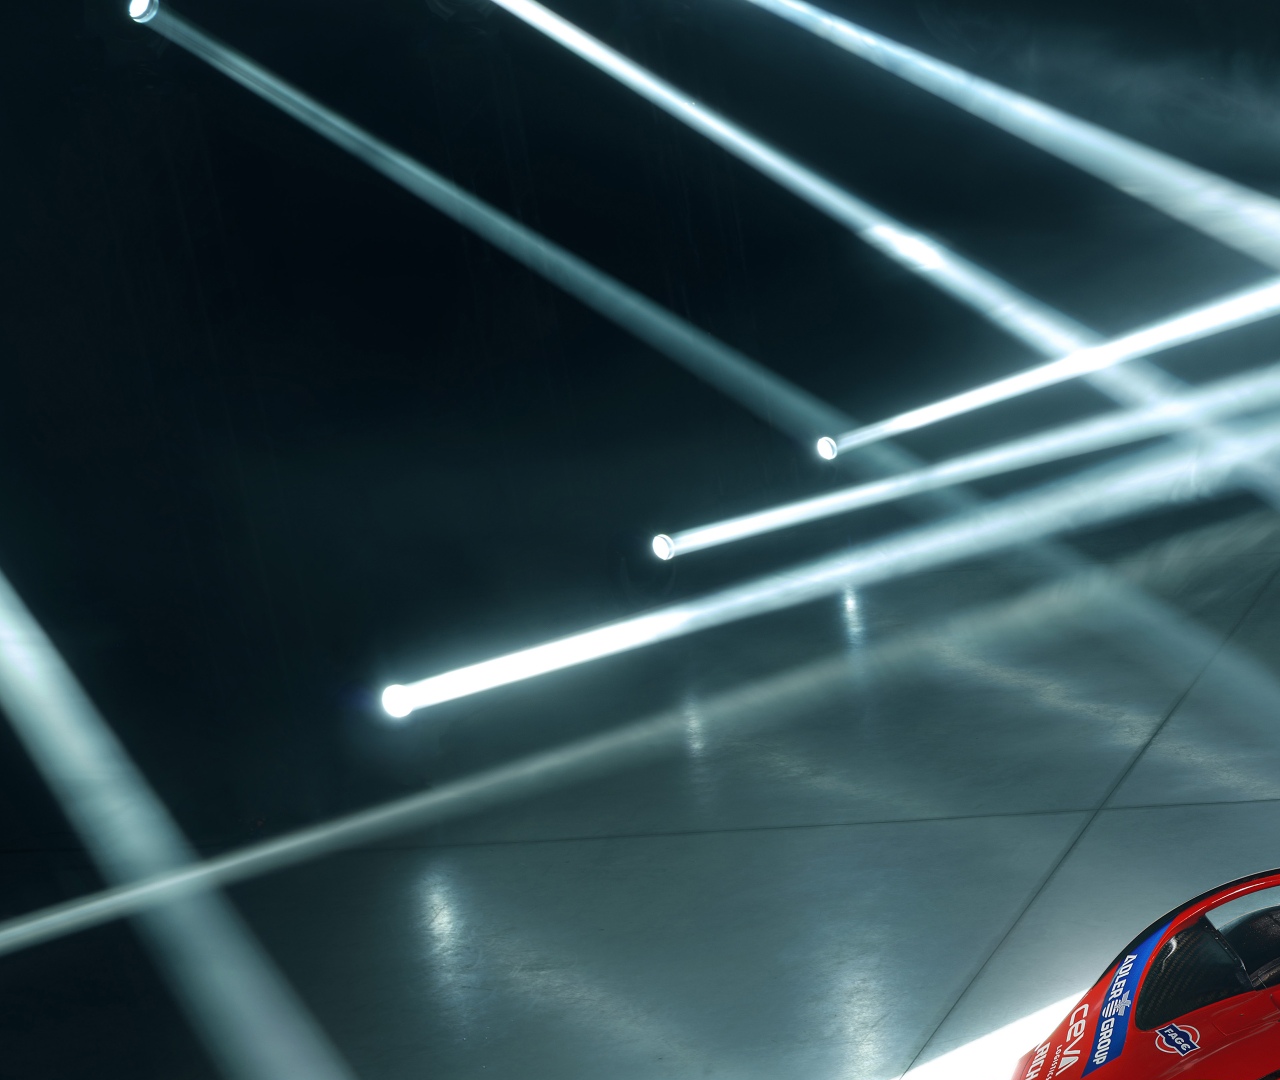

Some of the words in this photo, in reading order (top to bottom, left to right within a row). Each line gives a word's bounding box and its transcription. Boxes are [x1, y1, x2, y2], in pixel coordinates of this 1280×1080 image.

[1108, 954, 1137, 1001] ADLER
[1093, 1017, 1116, 1065] GROUP
[1164, 1027, 1191, 1051] FAGE
[1046, 1044, 1063, 1080] LOGISTICS
